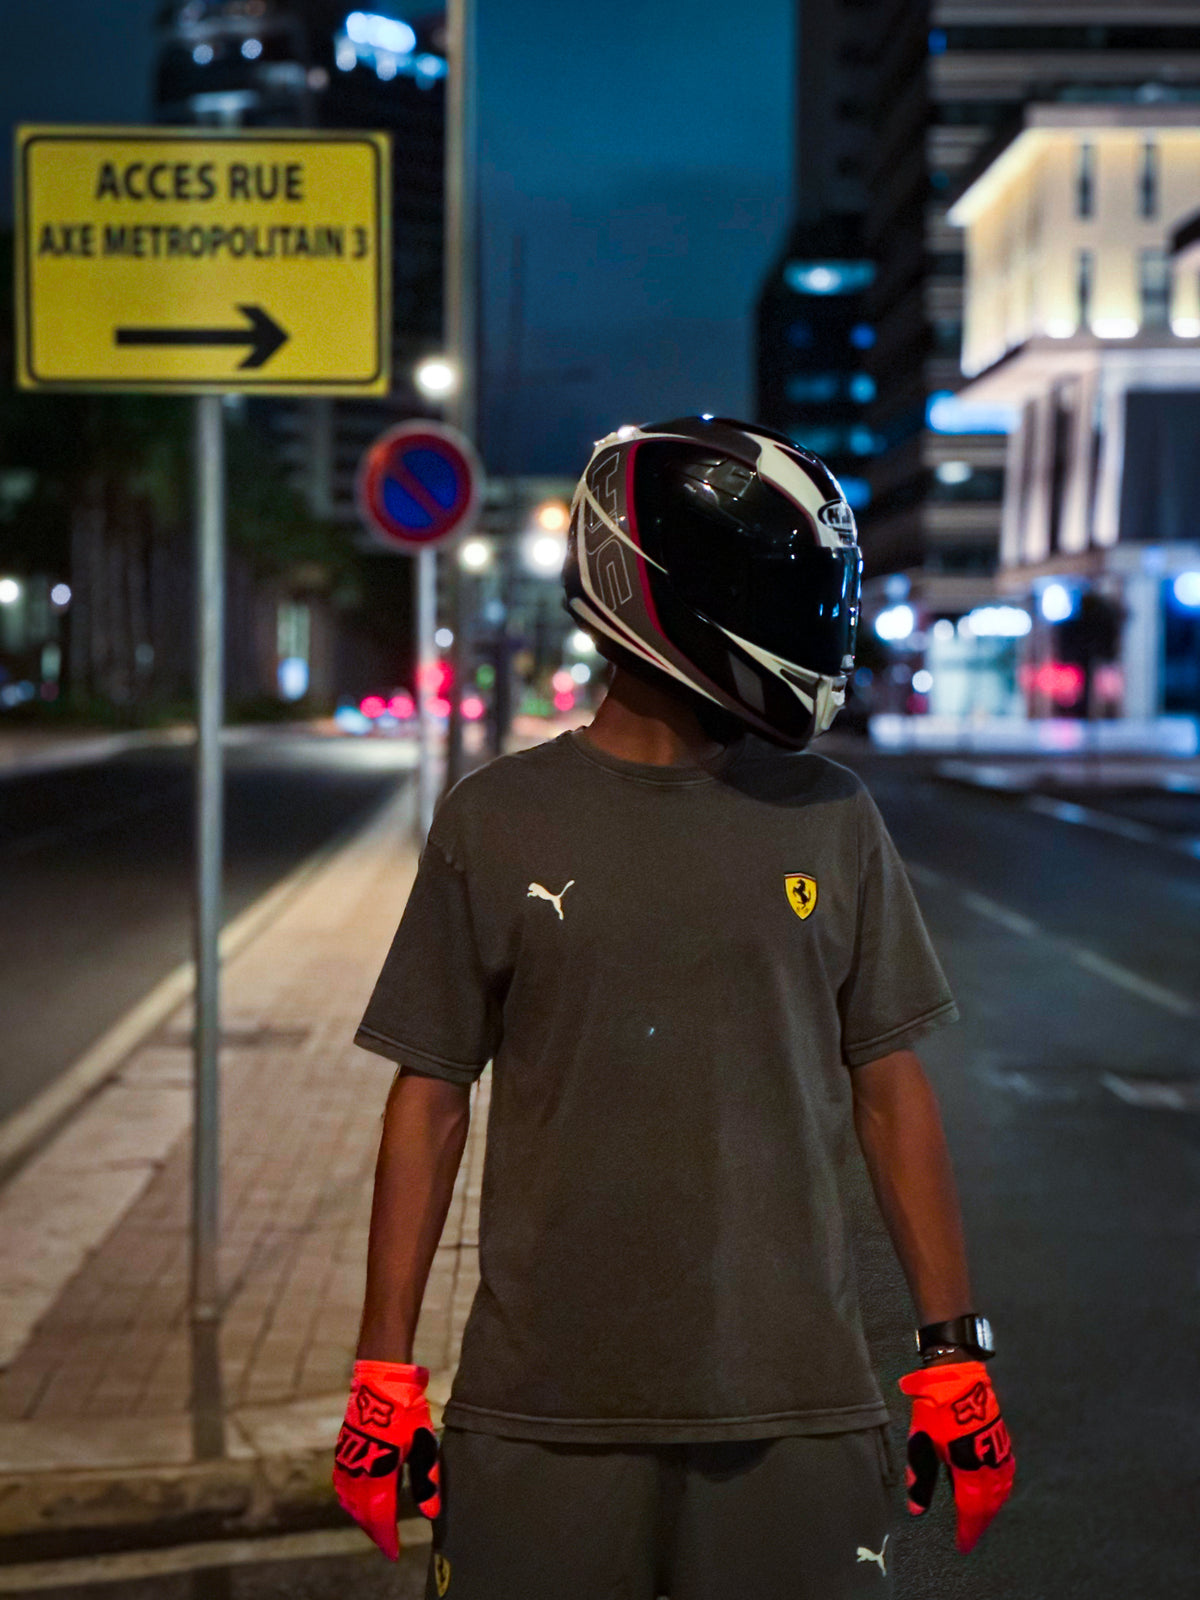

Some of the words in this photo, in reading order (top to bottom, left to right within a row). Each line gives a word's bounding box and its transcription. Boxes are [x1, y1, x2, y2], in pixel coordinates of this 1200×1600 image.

[95, 160, 217, 203] ACCES
[228, 163, 304, 202] RUE
[38, 223, 95, 259] AXE
[102, 223, 344, 259] METROPOLITAIN
[352, 226, 368, 259] 3
